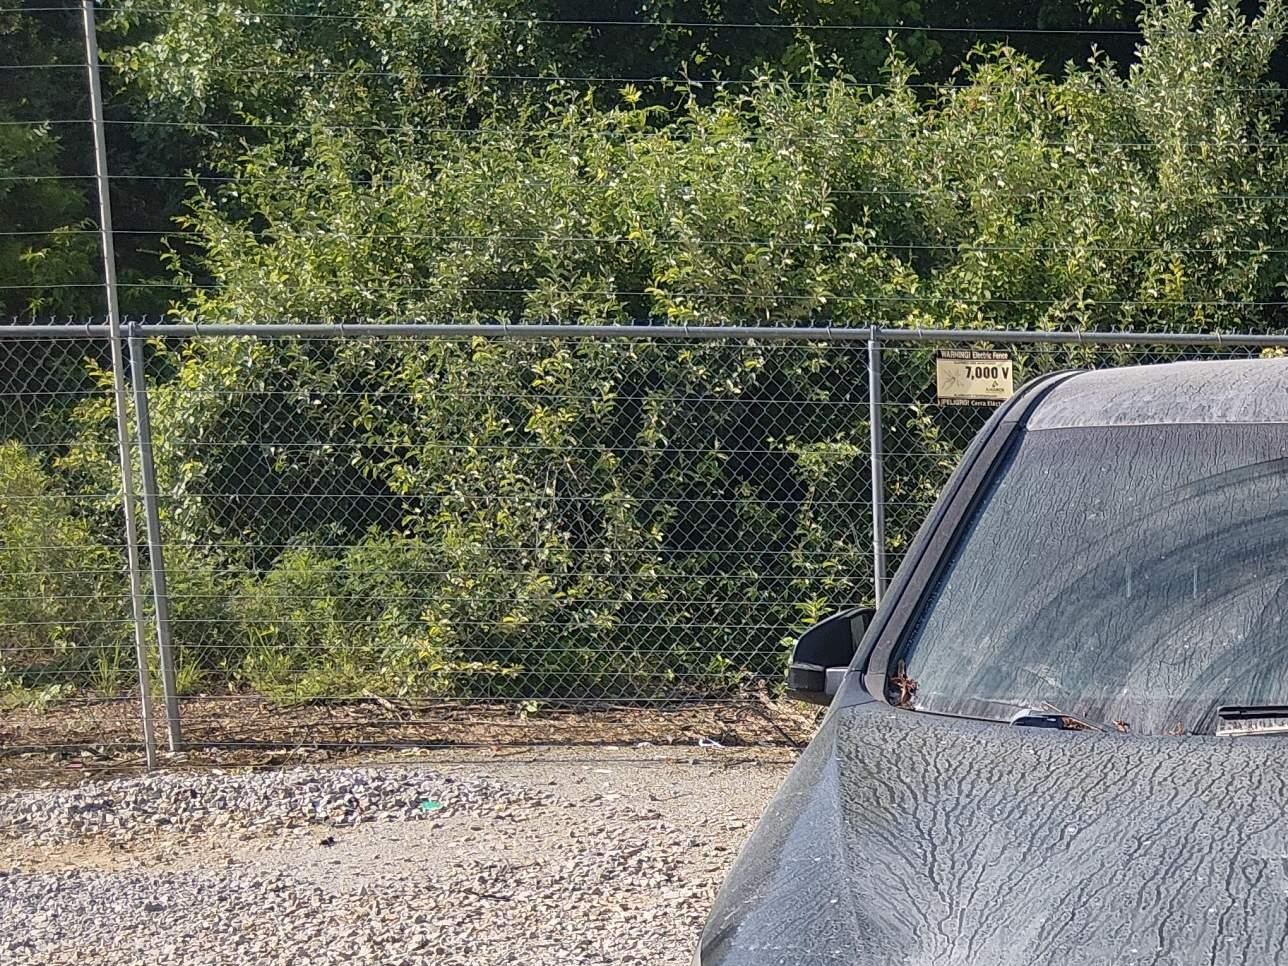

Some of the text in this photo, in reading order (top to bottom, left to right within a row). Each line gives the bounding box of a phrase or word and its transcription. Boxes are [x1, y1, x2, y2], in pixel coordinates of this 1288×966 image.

[972, 351, 992, 360] Electric
[992, 352, 1009, 360] Fence
[965, 366, 1010, 380] 7,000 V
